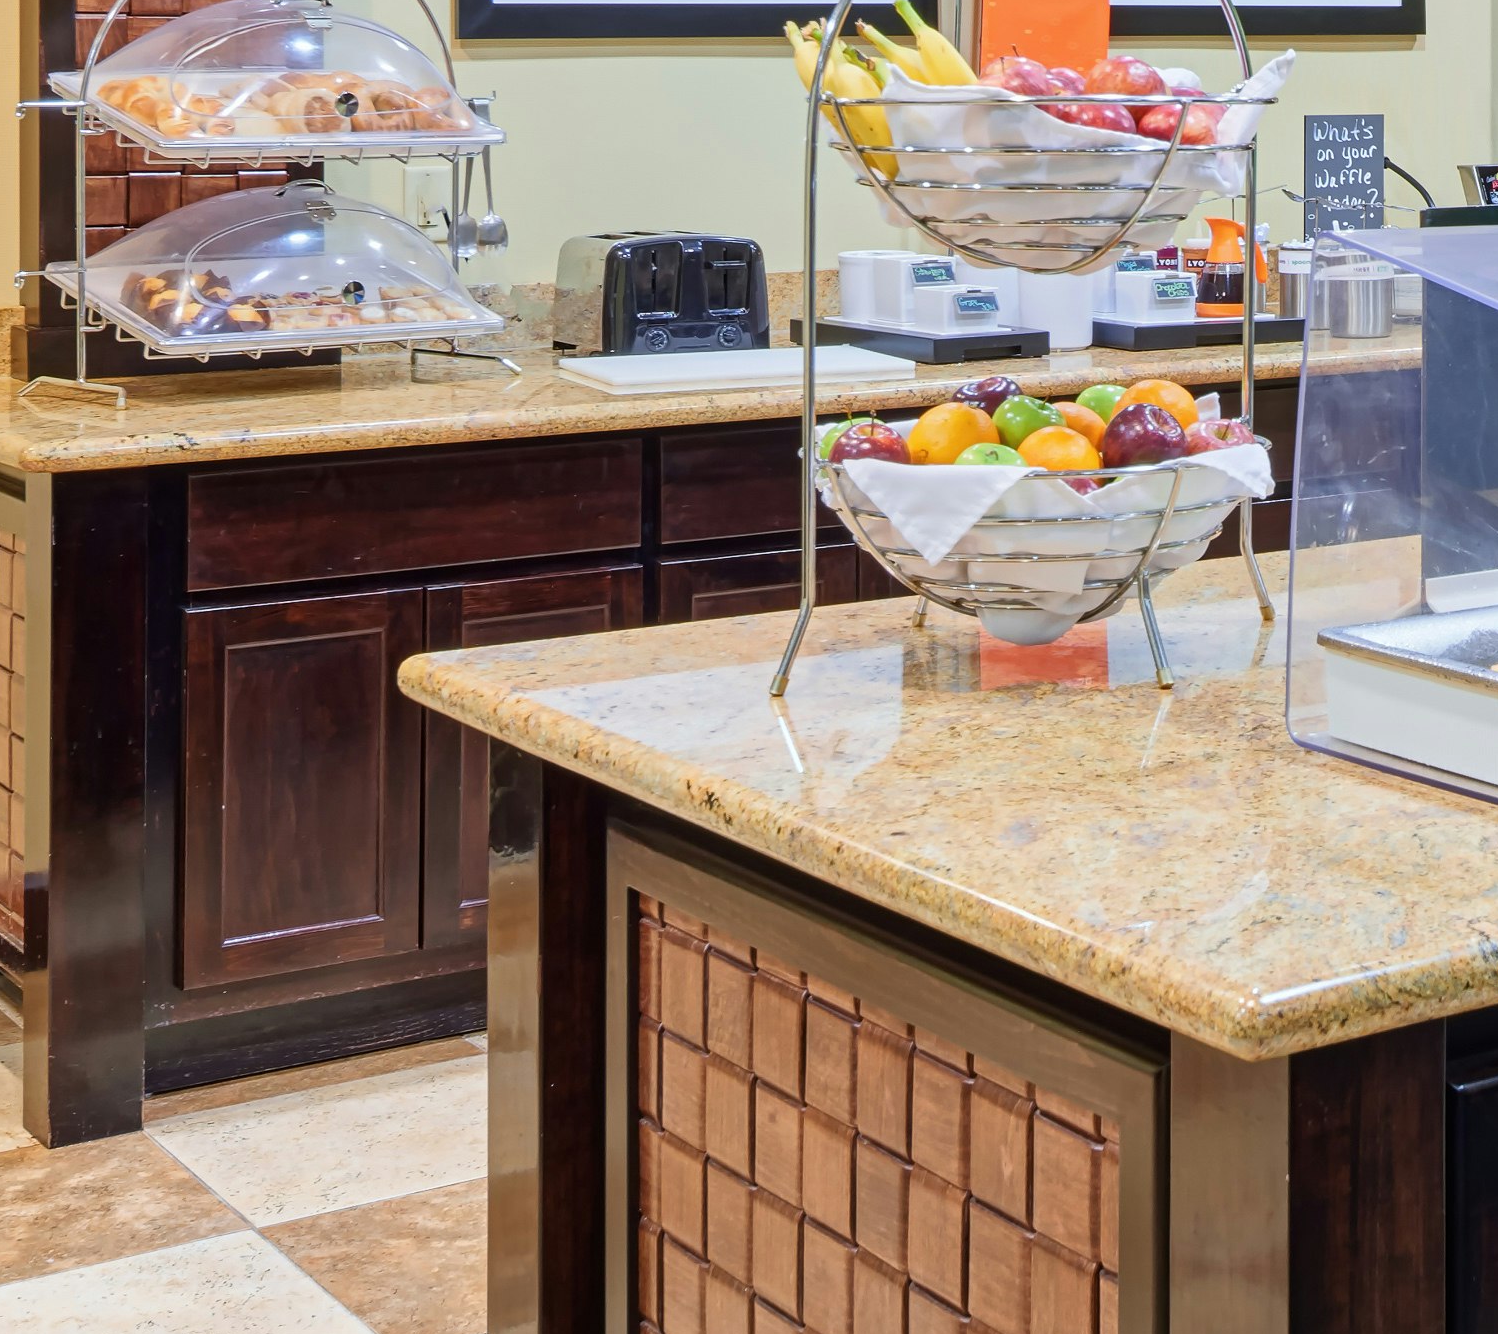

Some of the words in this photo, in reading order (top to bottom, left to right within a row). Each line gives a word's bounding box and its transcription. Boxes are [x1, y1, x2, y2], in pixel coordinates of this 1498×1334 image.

[1313, 118, 1374, 143] What's
[1317, 148, 1335, 162] on
[1341, 145, 1378, 168] your
